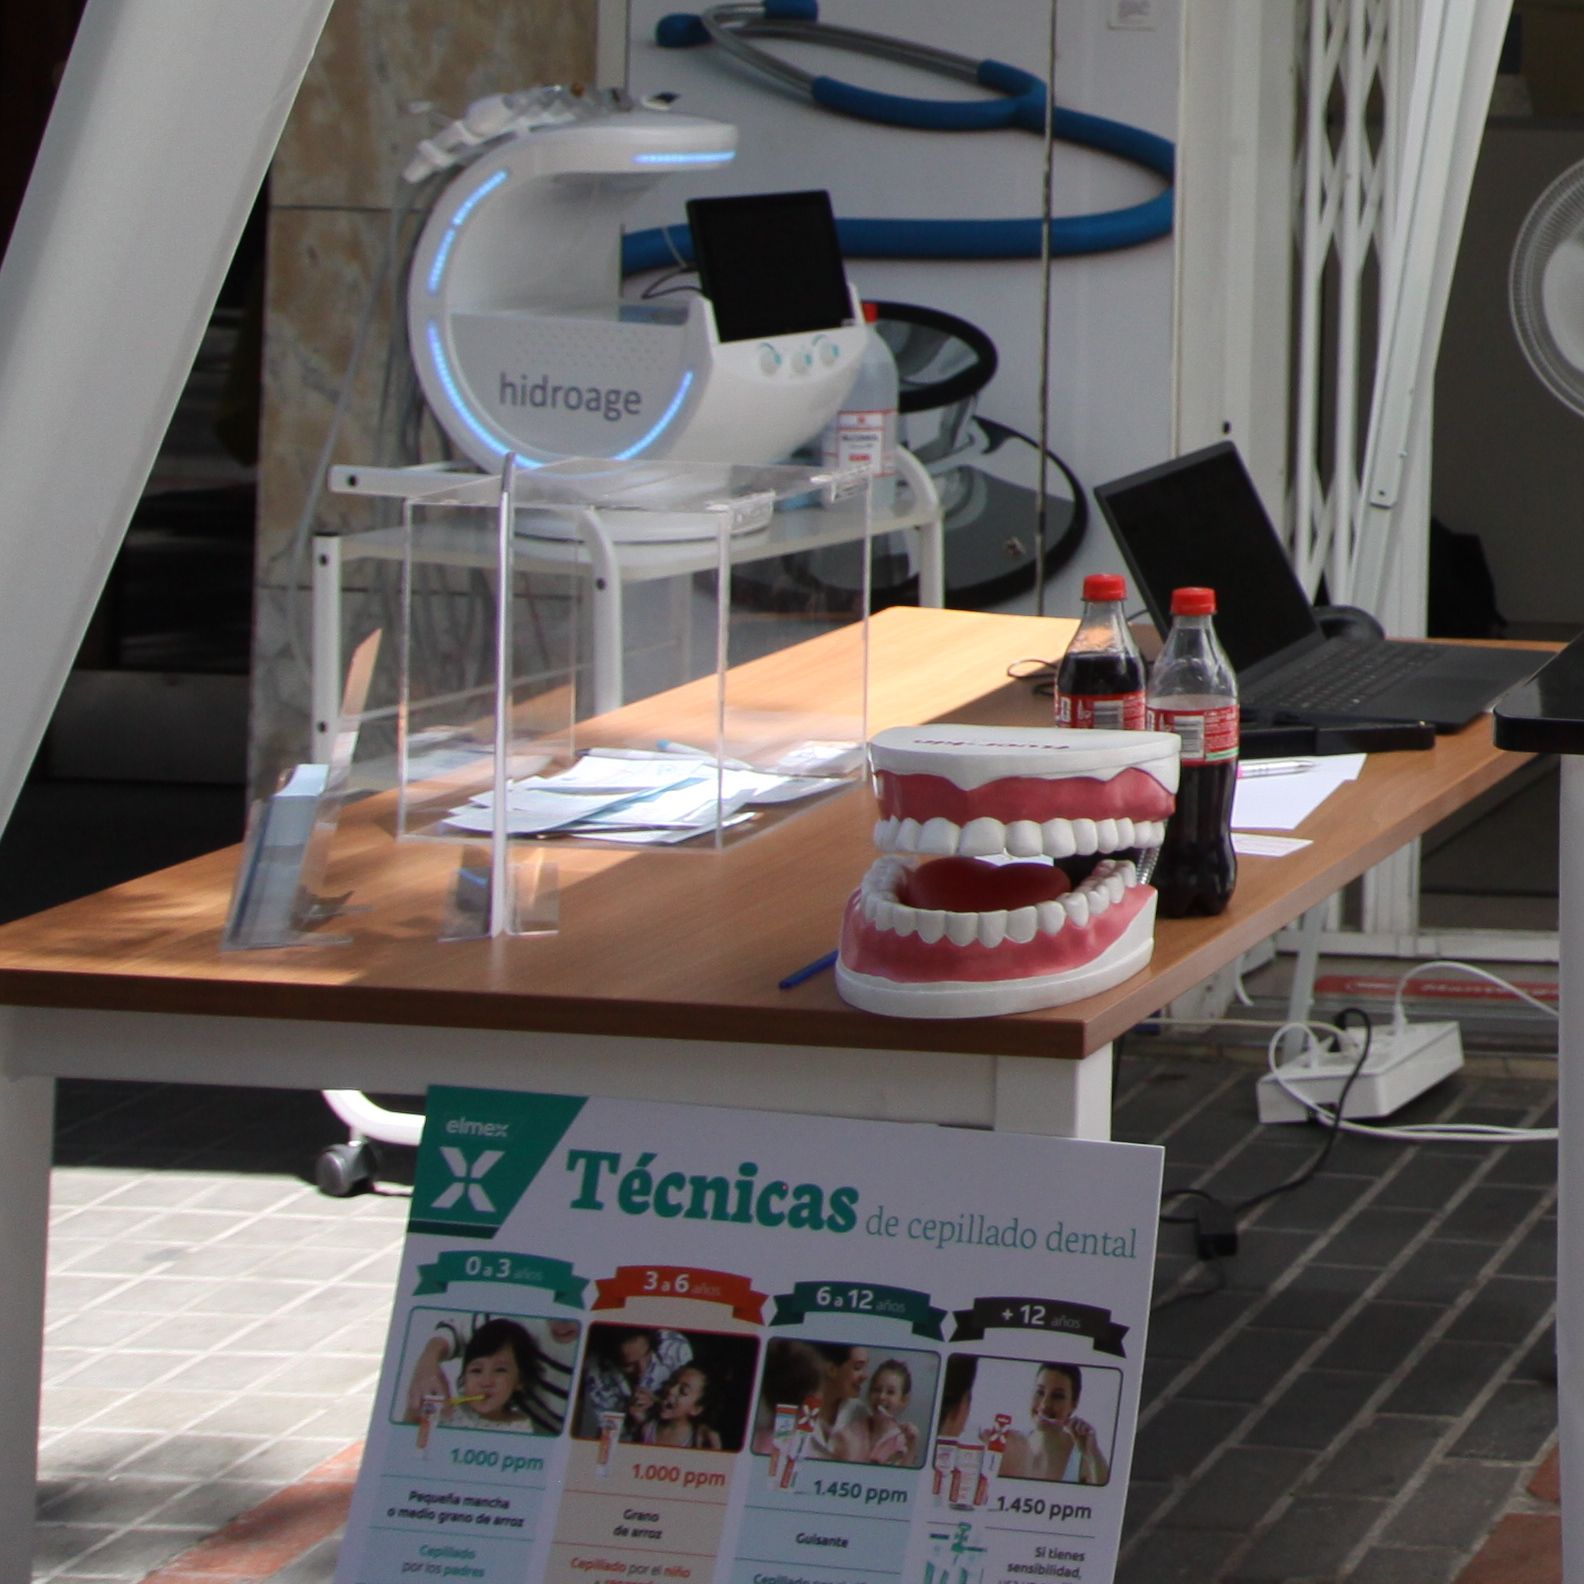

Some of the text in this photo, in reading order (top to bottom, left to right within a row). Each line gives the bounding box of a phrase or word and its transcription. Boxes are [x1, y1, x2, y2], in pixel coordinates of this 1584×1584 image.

[500, 373, 642, 420] hidroage
[445, 1117, 509, 1138] elmex
[566, 1149, 1137, 1260] Técnicas de cepillado dental
[465, 1255, 543, 1282] 0 a 3 años
[643, 1271, 658, 1290] 3
[661, 1282, 670, 1292] a
[674, 1273, 689, 1293] 6
[816, 1286, 906, 1314] 6 a 12 años
[1020, 1305, 1046, 1325] 12
[1050, 1312, 1081, 1329] años
[450, 1448, 544, 1472] 1.000 ppm
[633, 1464, 726, 1488] 1.000 ppm
[408, 1490, 510, 1510] Pequeña mancha
[813, 1480, 908, 1505] 1.450 ppm
[398, 1507, 435, 1520] medio
[438, 1512, 473, 1525] grano
[475, 1512, 491, 1525] de
[493, 1517, 525, 1528] arroz
[623, 1508, 660, 1522] Grano
[997, 1496, 1092, 1520] 1.450 ppm
[613, 1525, 663, 1540] de arroz
[796, 1532, 849, 1548] Guisante
[419, 1544, 476, 1560] Cepillado
[1035, 1546, 1086, 1562] Si tienes
[402, 1561, 485, 1578] por los padres
[570, 1557, 627, 1572] Cepillado
[628, 1565, 648, 1576] por
[664, 1566, 691, 1578] niño
